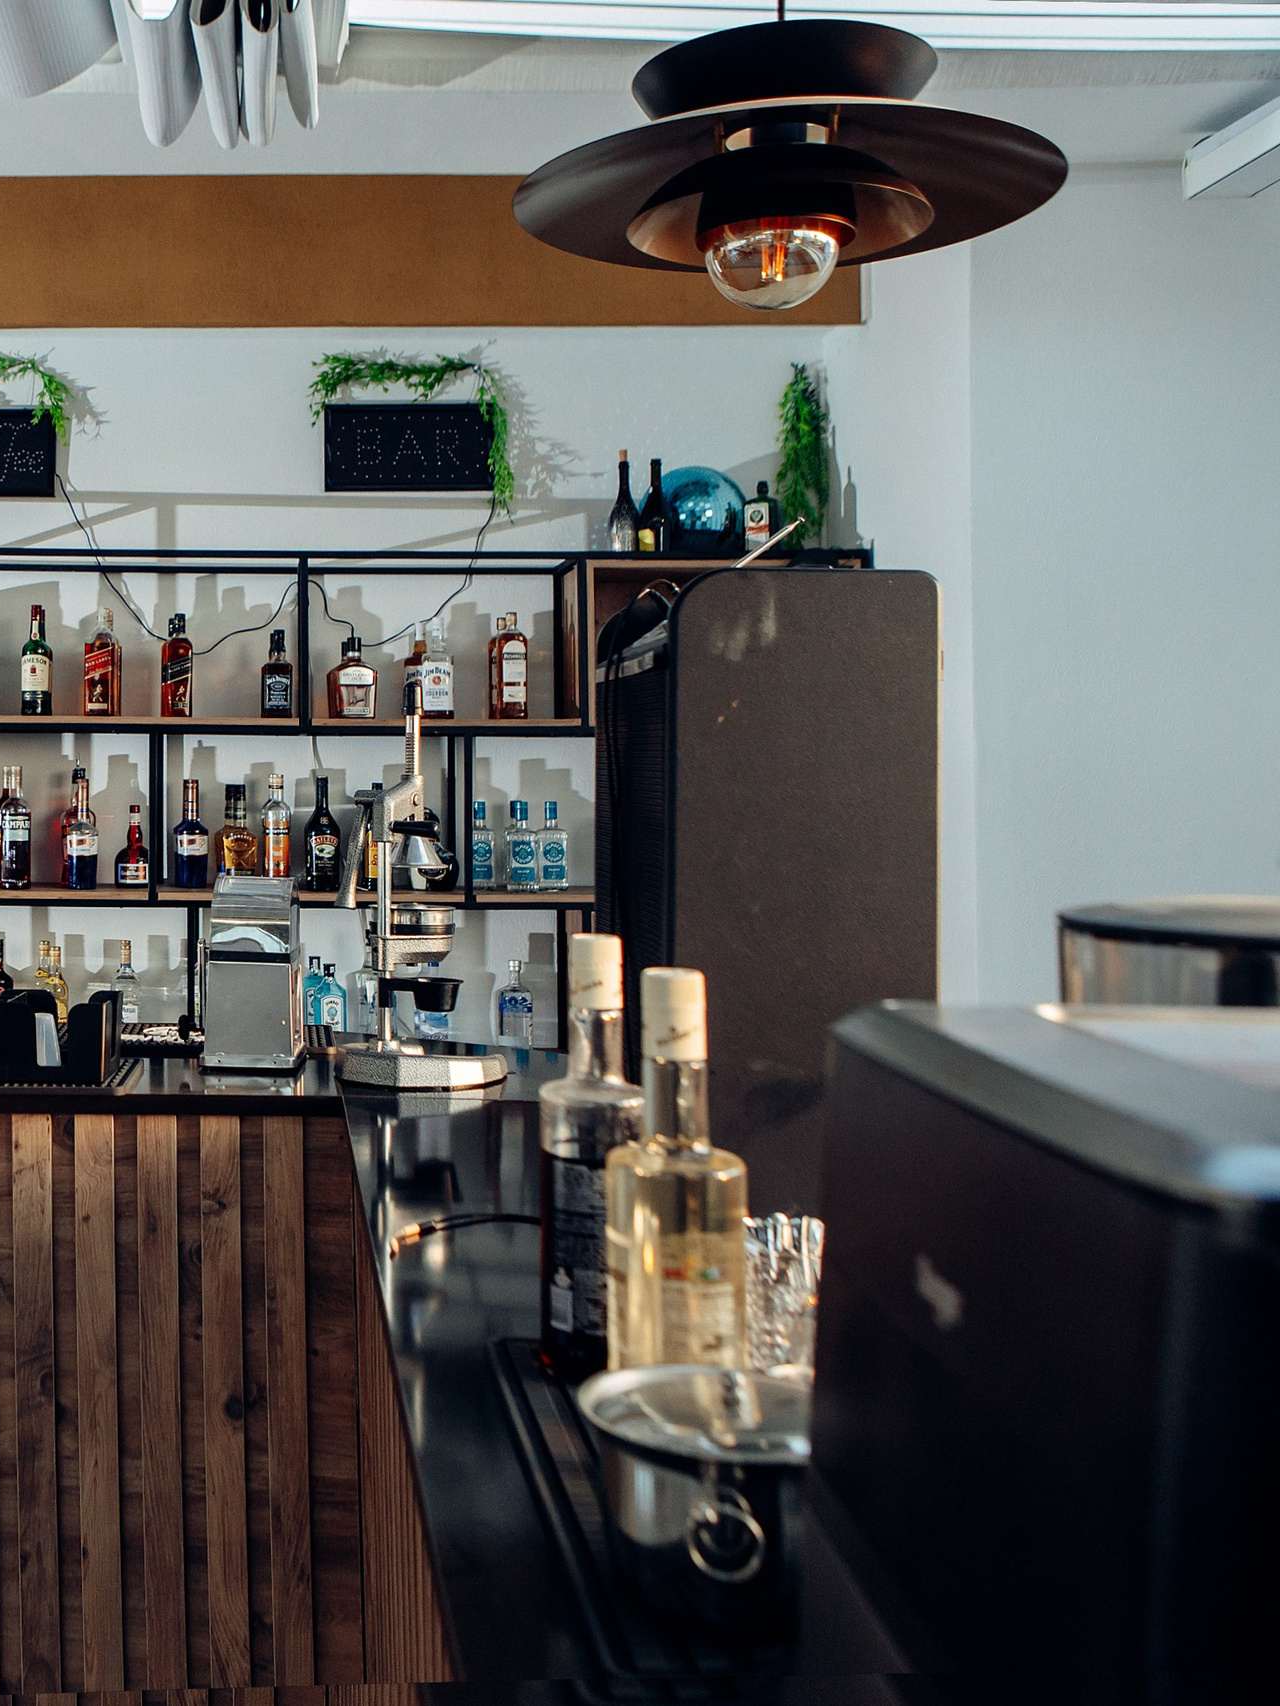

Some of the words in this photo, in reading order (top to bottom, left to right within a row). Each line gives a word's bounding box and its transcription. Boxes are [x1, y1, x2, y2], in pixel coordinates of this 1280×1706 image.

[357, 428, 460, 465] BAR
[424, 669, 435, 678] JIM
[434, 666, 451, 678] BEAM
